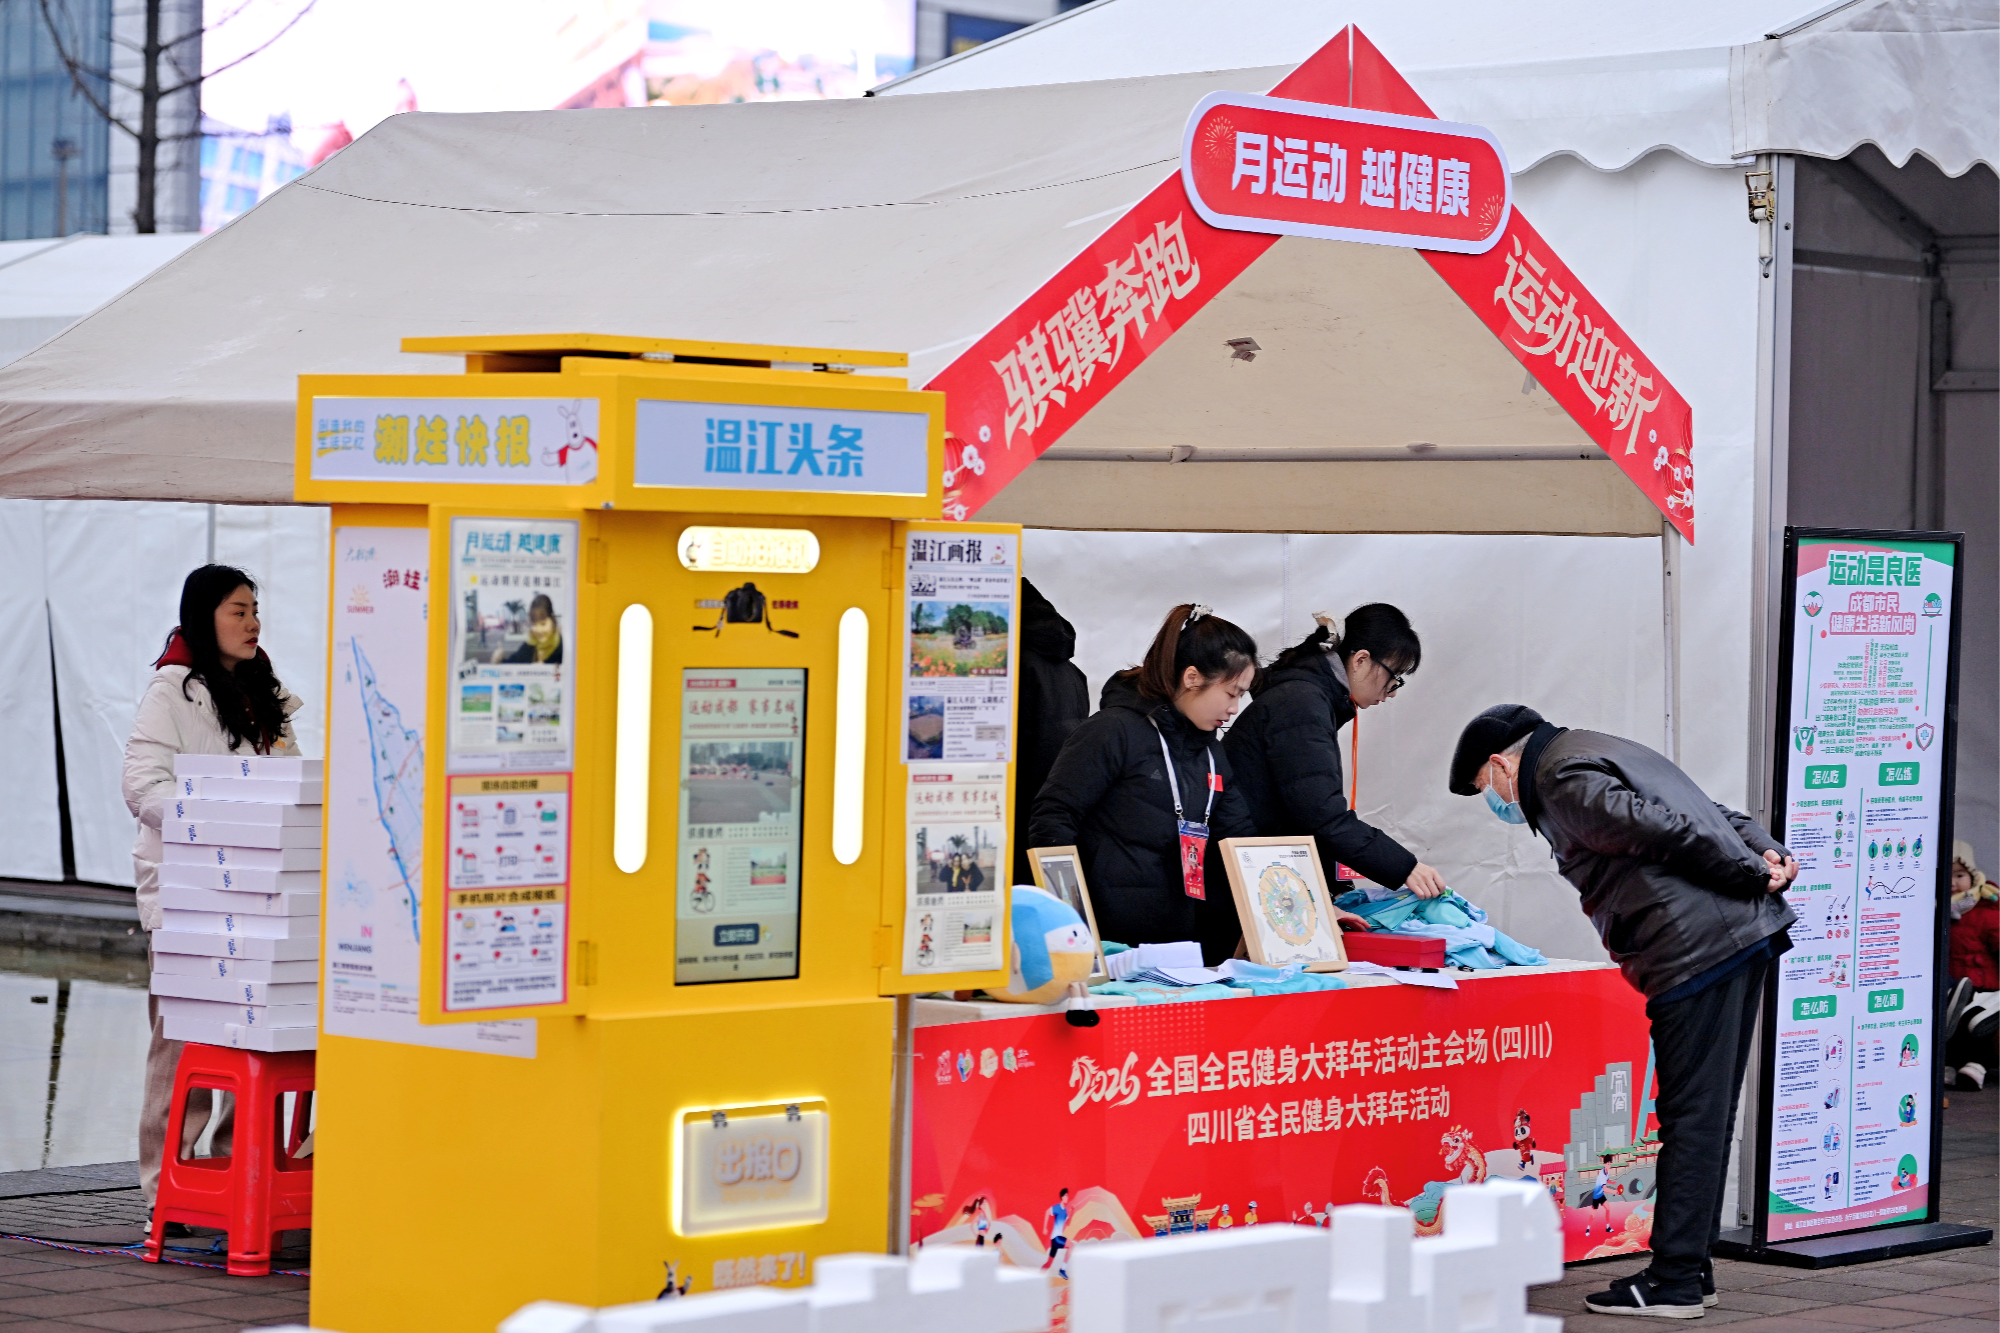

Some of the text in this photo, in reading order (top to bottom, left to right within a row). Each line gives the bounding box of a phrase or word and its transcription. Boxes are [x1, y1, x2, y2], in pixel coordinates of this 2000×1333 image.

[1231, 131, 1471, 218] 月运动 越健康
[990, 212, 1201, 448] 骐骥奔跑
[1493, 233, 1663, 455] 运动迎新
[318, 436, 365, 450] 生活记忆
[374, 414, 531, 467] 潮娃快报
[704, 418, 864, 477] 温江头条
[911, 539, 982, 564] 温江画报
[1828, 553, 1922, 586] 运动是良医
[347, 605, 374, 614] SUMMER
[1850, 593, 1899, 613] 成都市民
[1831, 614, 1915, 633] 健康生活新风尚
[1811, 769, 1840, 785] 怎么吃
[1885, 766, 1913, 782] 怎么练
[361, 926, 373, 938] IN
[338, 942, 372, 954] WENJIANG
[1800, 1000, 1829, 1016] 怎么防
[1873, 993, 1898, 1009] 怎么调
[1068, 1051, 1141, 1114] 2026
[1188, 1085, 1450, 1146] 四川省全民健身大拜年活动
[716, 1137, 801, 1185] 出报口
